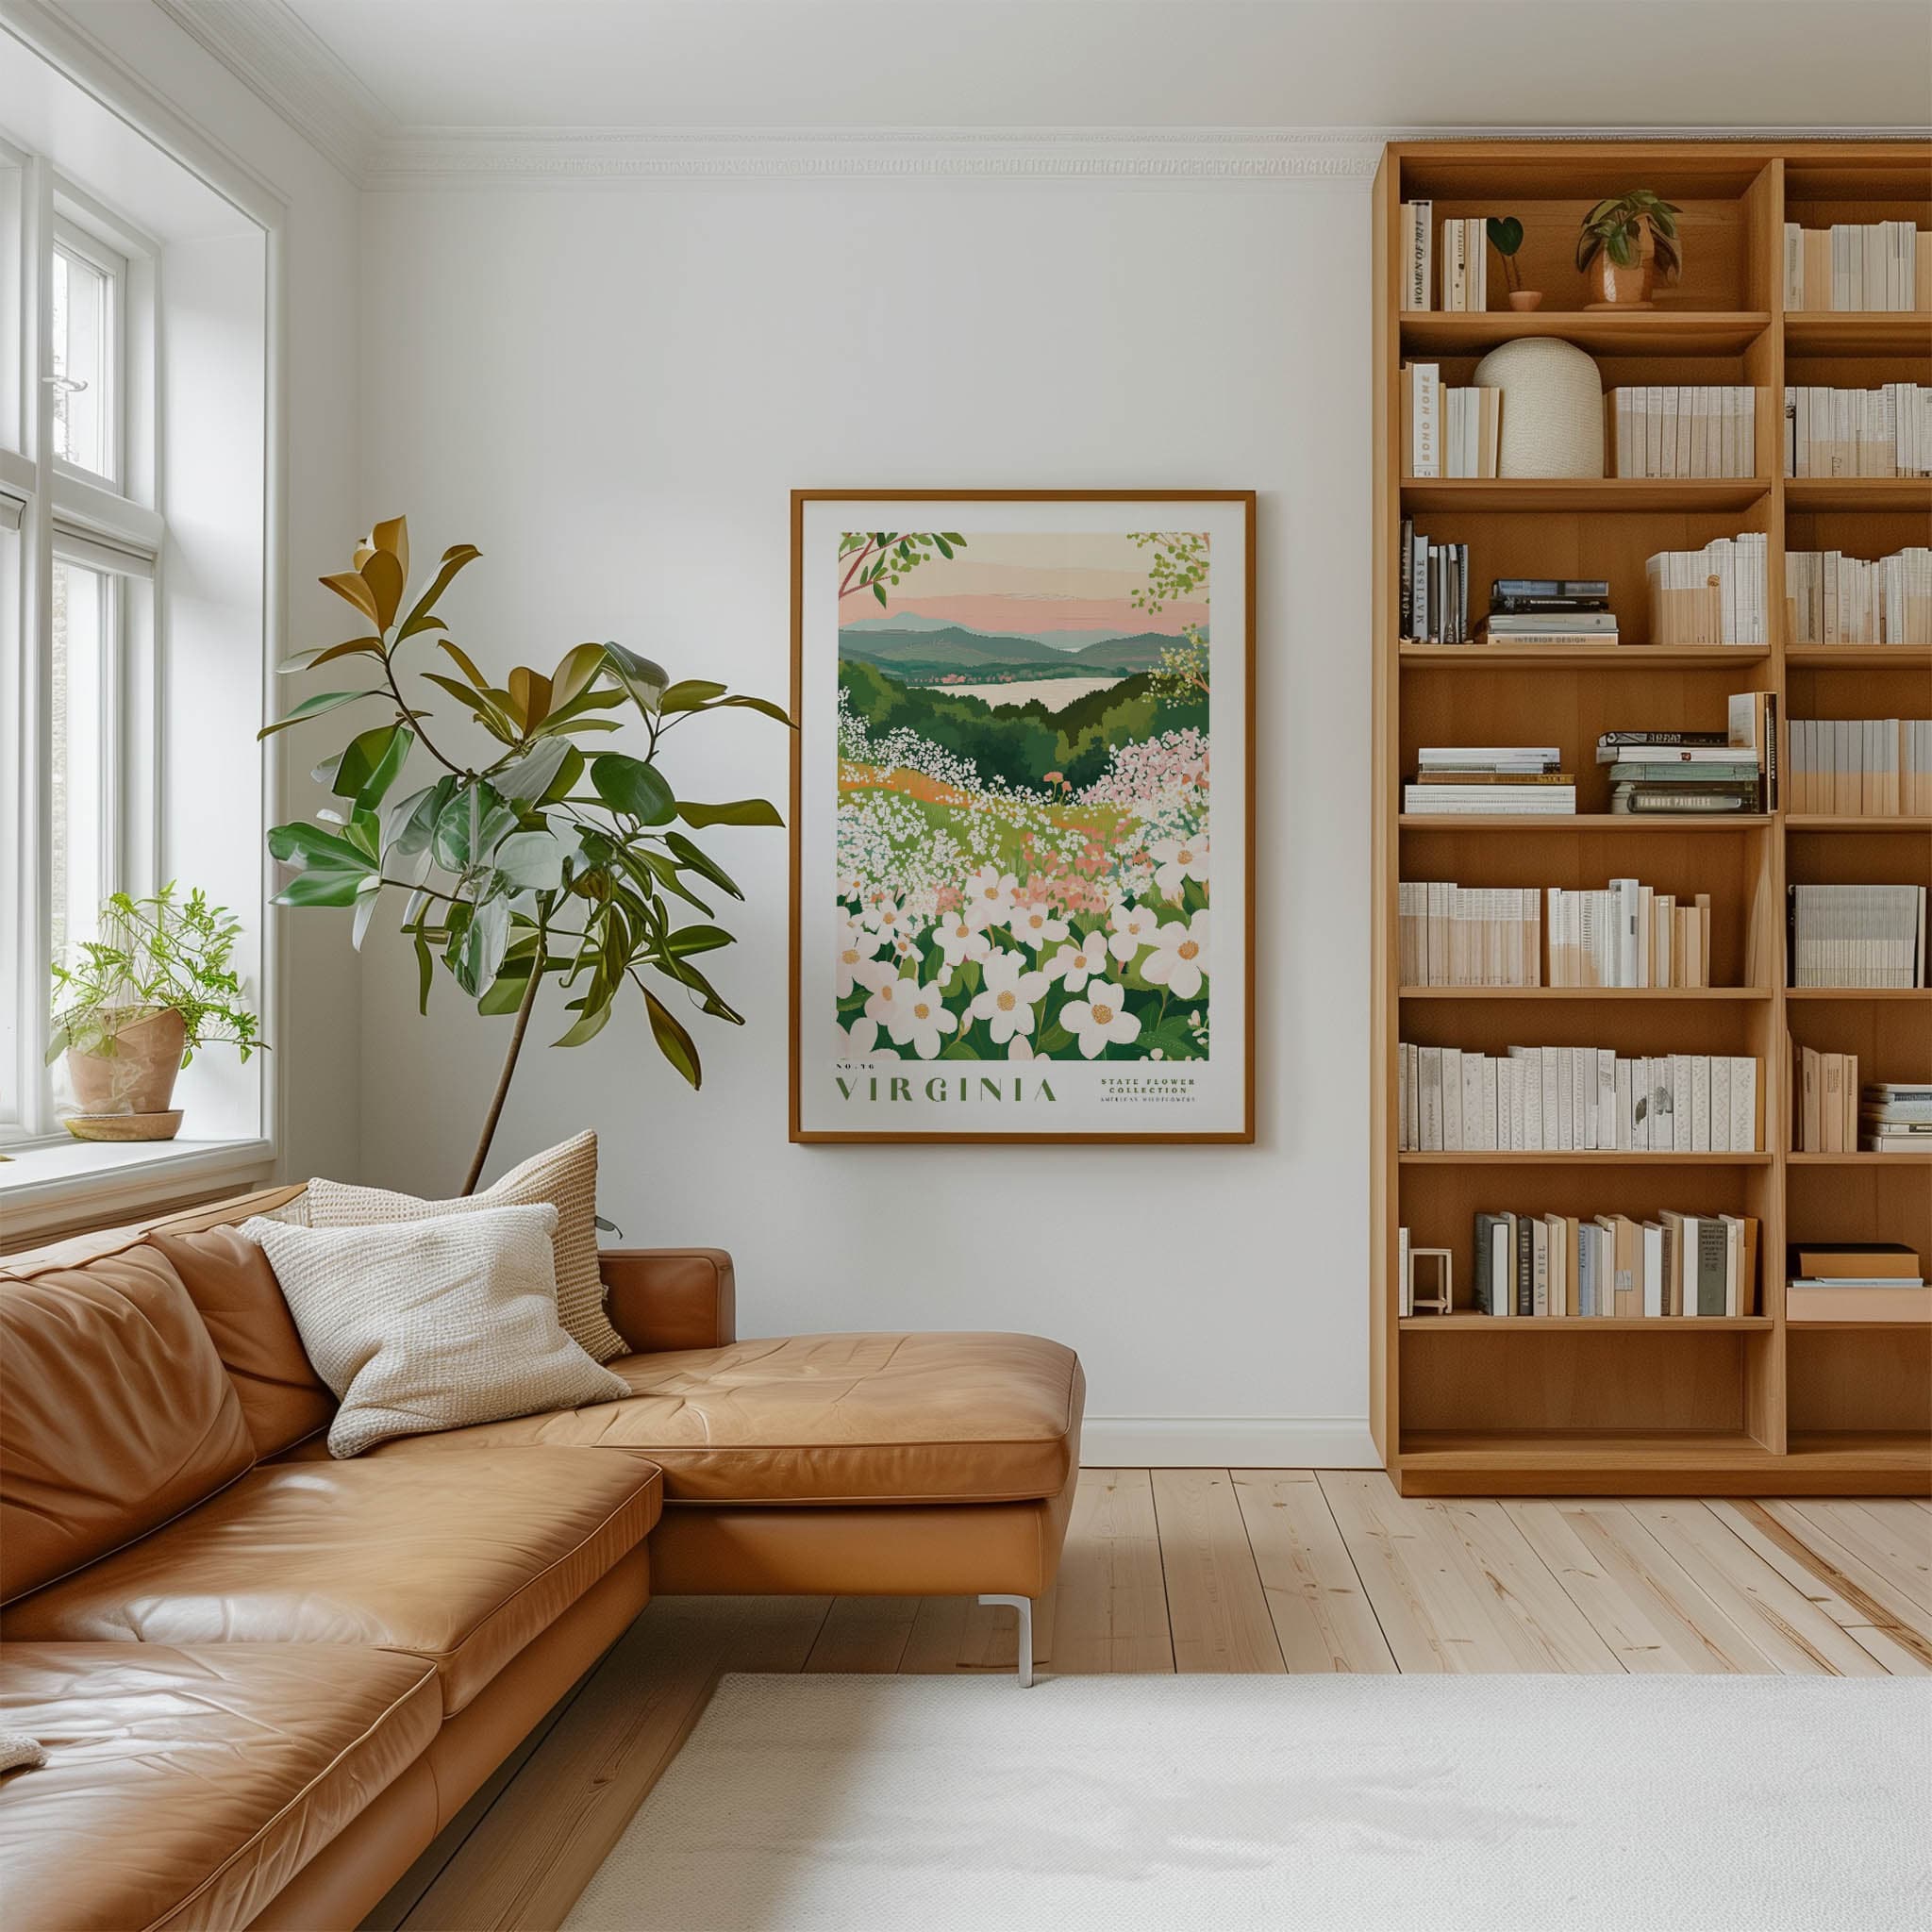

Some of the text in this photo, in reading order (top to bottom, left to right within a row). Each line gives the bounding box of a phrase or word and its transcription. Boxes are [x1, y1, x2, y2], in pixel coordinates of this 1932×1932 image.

[1413, 243, 1425, 260] OF
[1413, 262, 1424, 305] WOMEN
[1422, 375, 1431, 461] BOHO HOME
[1416, 559, 1425, 625] MATISSE
[1640, 797, 1671, 807] FAMOUS
[836, 1077, 1057, 1102] VIRGINIA
[1537, 1245, 1546, 1305] IVY BIEL
